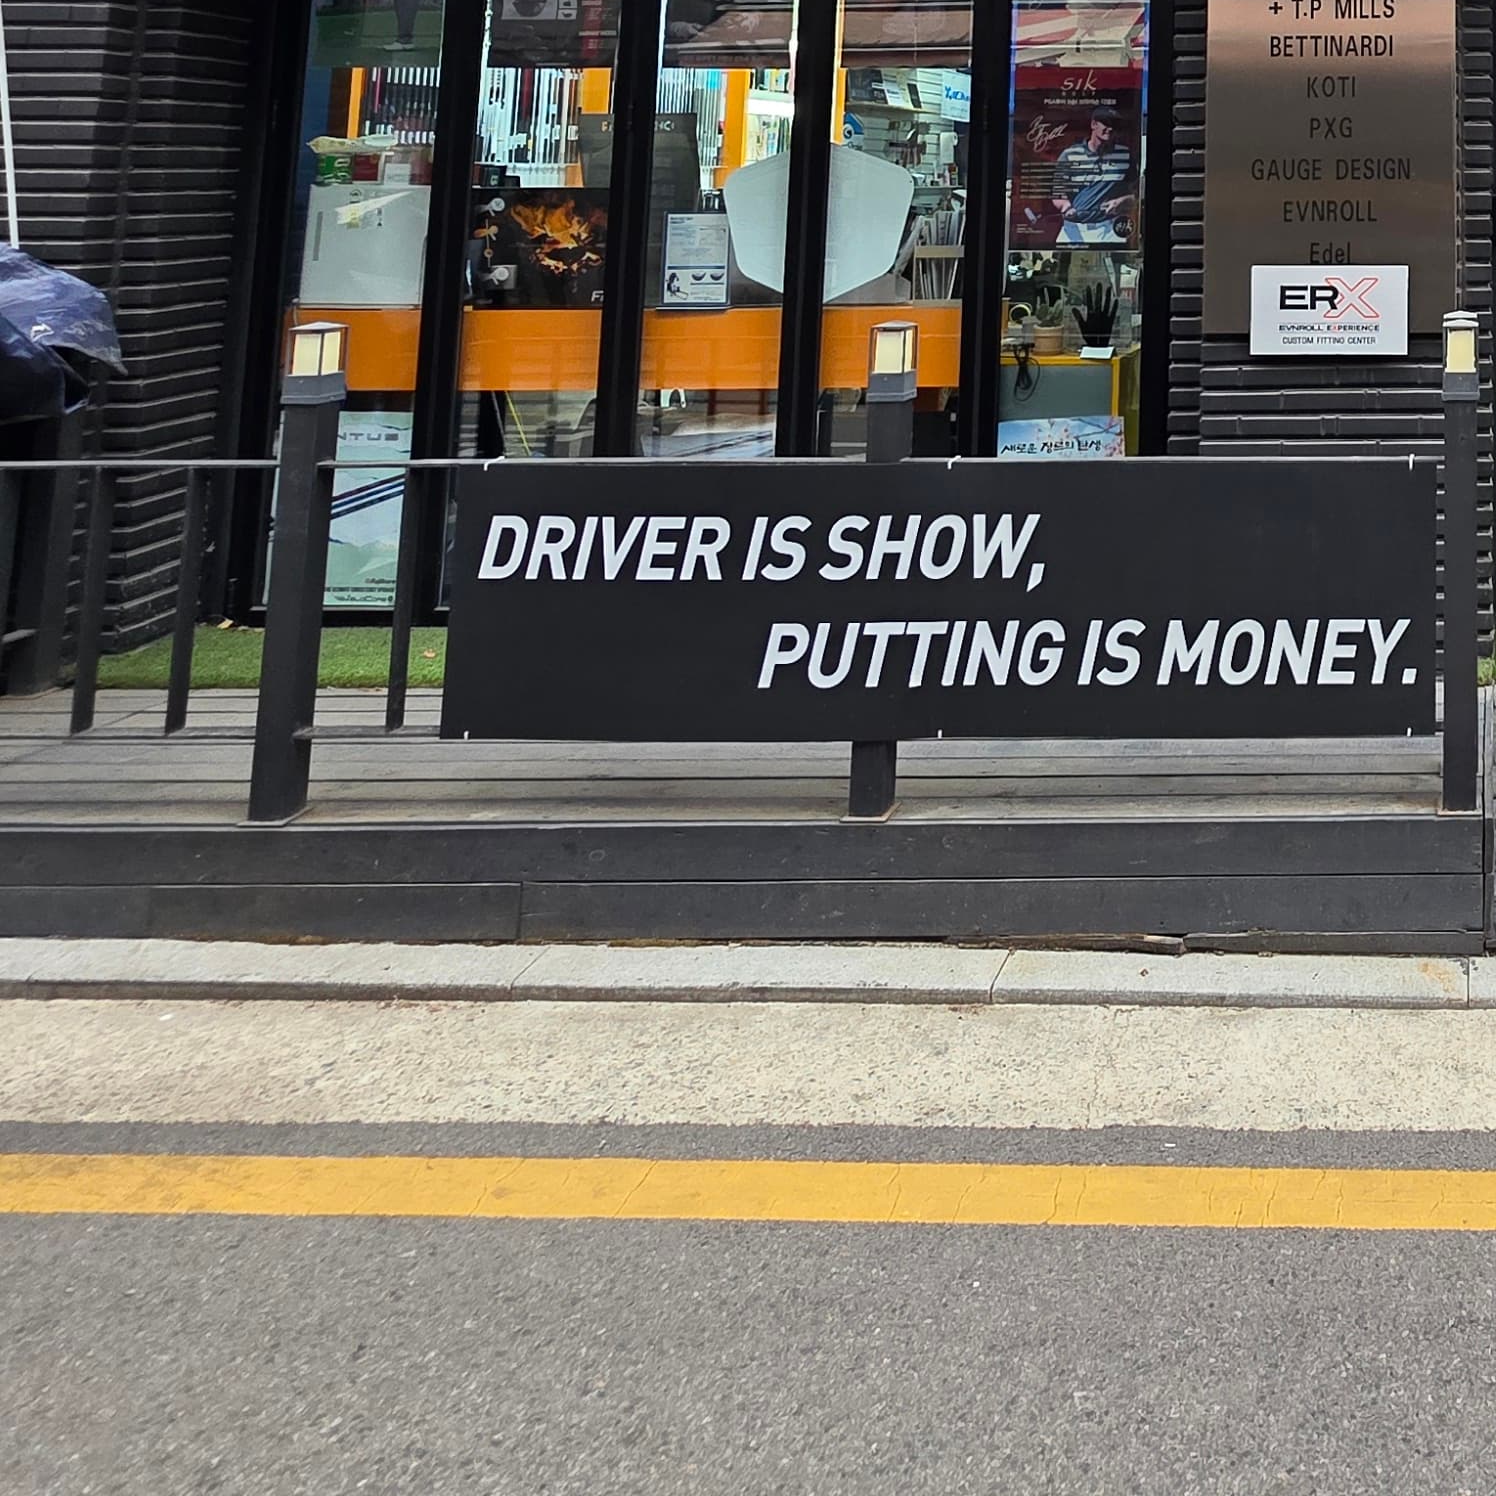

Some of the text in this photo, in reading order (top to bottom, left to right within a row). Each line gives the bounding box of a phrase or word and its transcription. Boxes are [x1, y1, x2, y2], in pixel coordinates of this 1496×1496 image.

[1270, 35, 1393, 57] BETTINARDI
[1307, 75, 1356, 98] KOTI
[1309, 117, 1353, 139] PXG
[1251, 158, 1411, 180] GAUGE DESIGN
[1283, 200, 1377, 222] EVNROLL
[1309, 242, 1352, 265] Edel
[1280, 277, 1380, 318] ERX
[1001, 443, 1038, 454] 새로운
[477, 512, 1045, 594] DRIVER IS SHOW,
[757, 618, 1418, 689] PUTTING IS MONEY.
